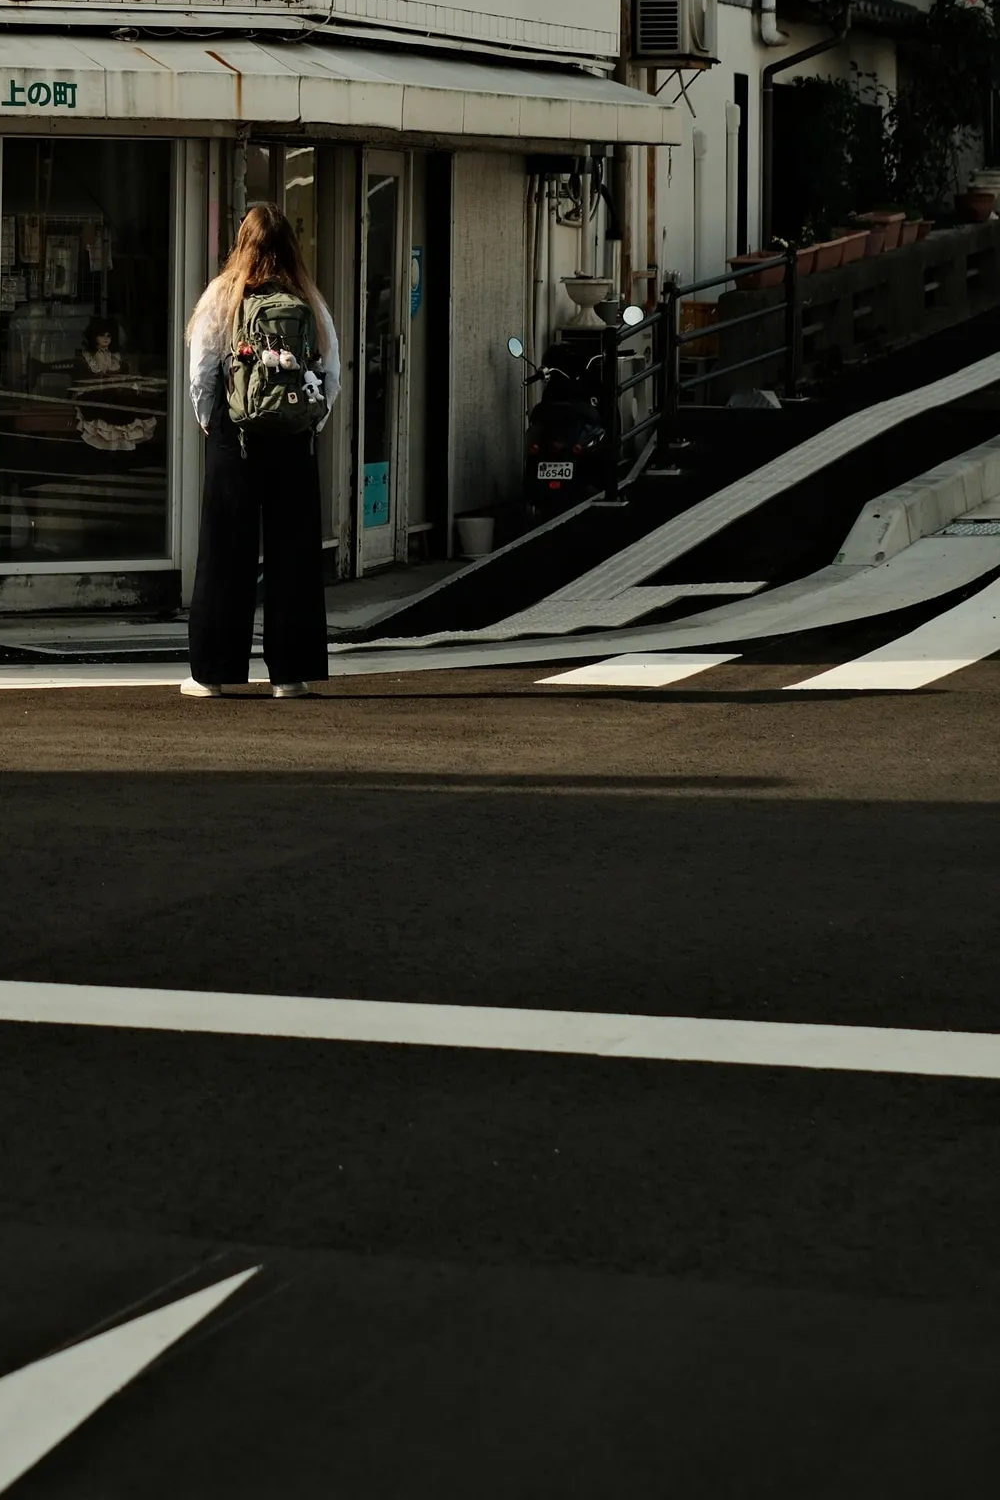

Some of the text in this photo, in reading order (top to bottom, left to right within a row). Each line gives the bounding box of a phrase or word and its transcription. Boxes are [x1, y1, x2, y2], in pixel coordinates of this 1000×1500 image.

[1, 79, 77, 109] 上の町
[546, 468, 571, 478] 6540
